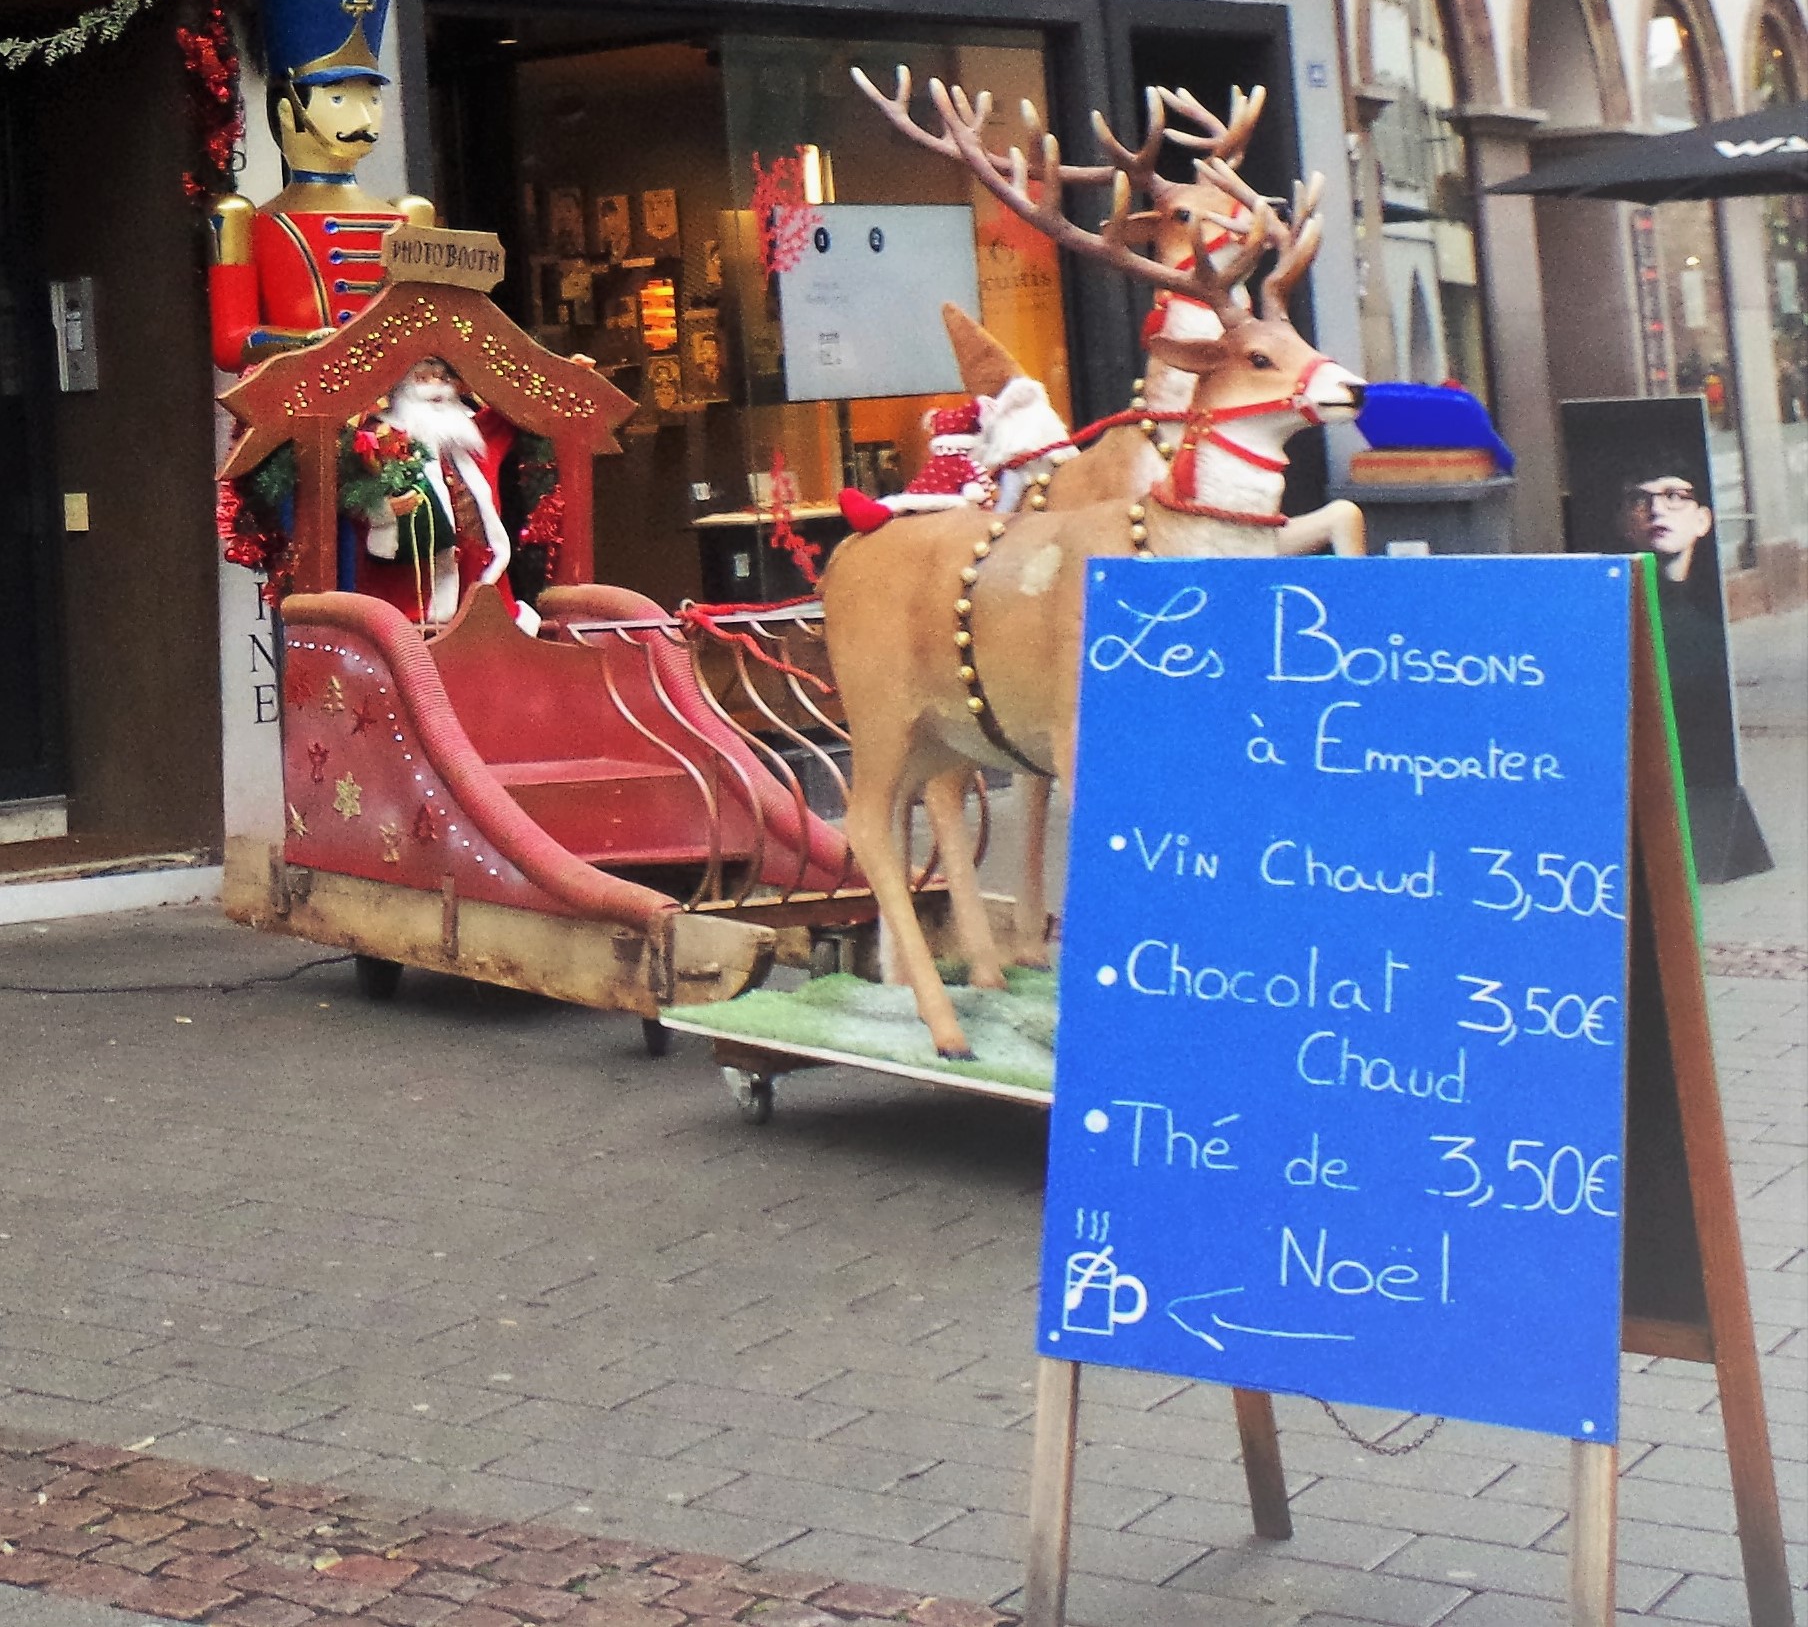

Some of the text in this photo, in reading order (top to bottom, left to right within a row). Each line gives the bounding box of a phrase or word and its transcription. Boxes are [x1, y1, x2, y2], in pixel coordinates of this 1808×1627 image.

[1089, 585, 1226, 680] Les
[1246, 713, 1287, 766] à
[1258, 838, 1440, 901] Chaud
[1466, 846, 1627, 922] 3,50€
[1124, 939, 1619, 1046] Chocolat 3,50€
[1295, 1028, 1472, 1105] Chaud
[1110, 1099, 1620, 1219] Thé de 3,50€
[1279, 1225, 1457, 1306] Noël
